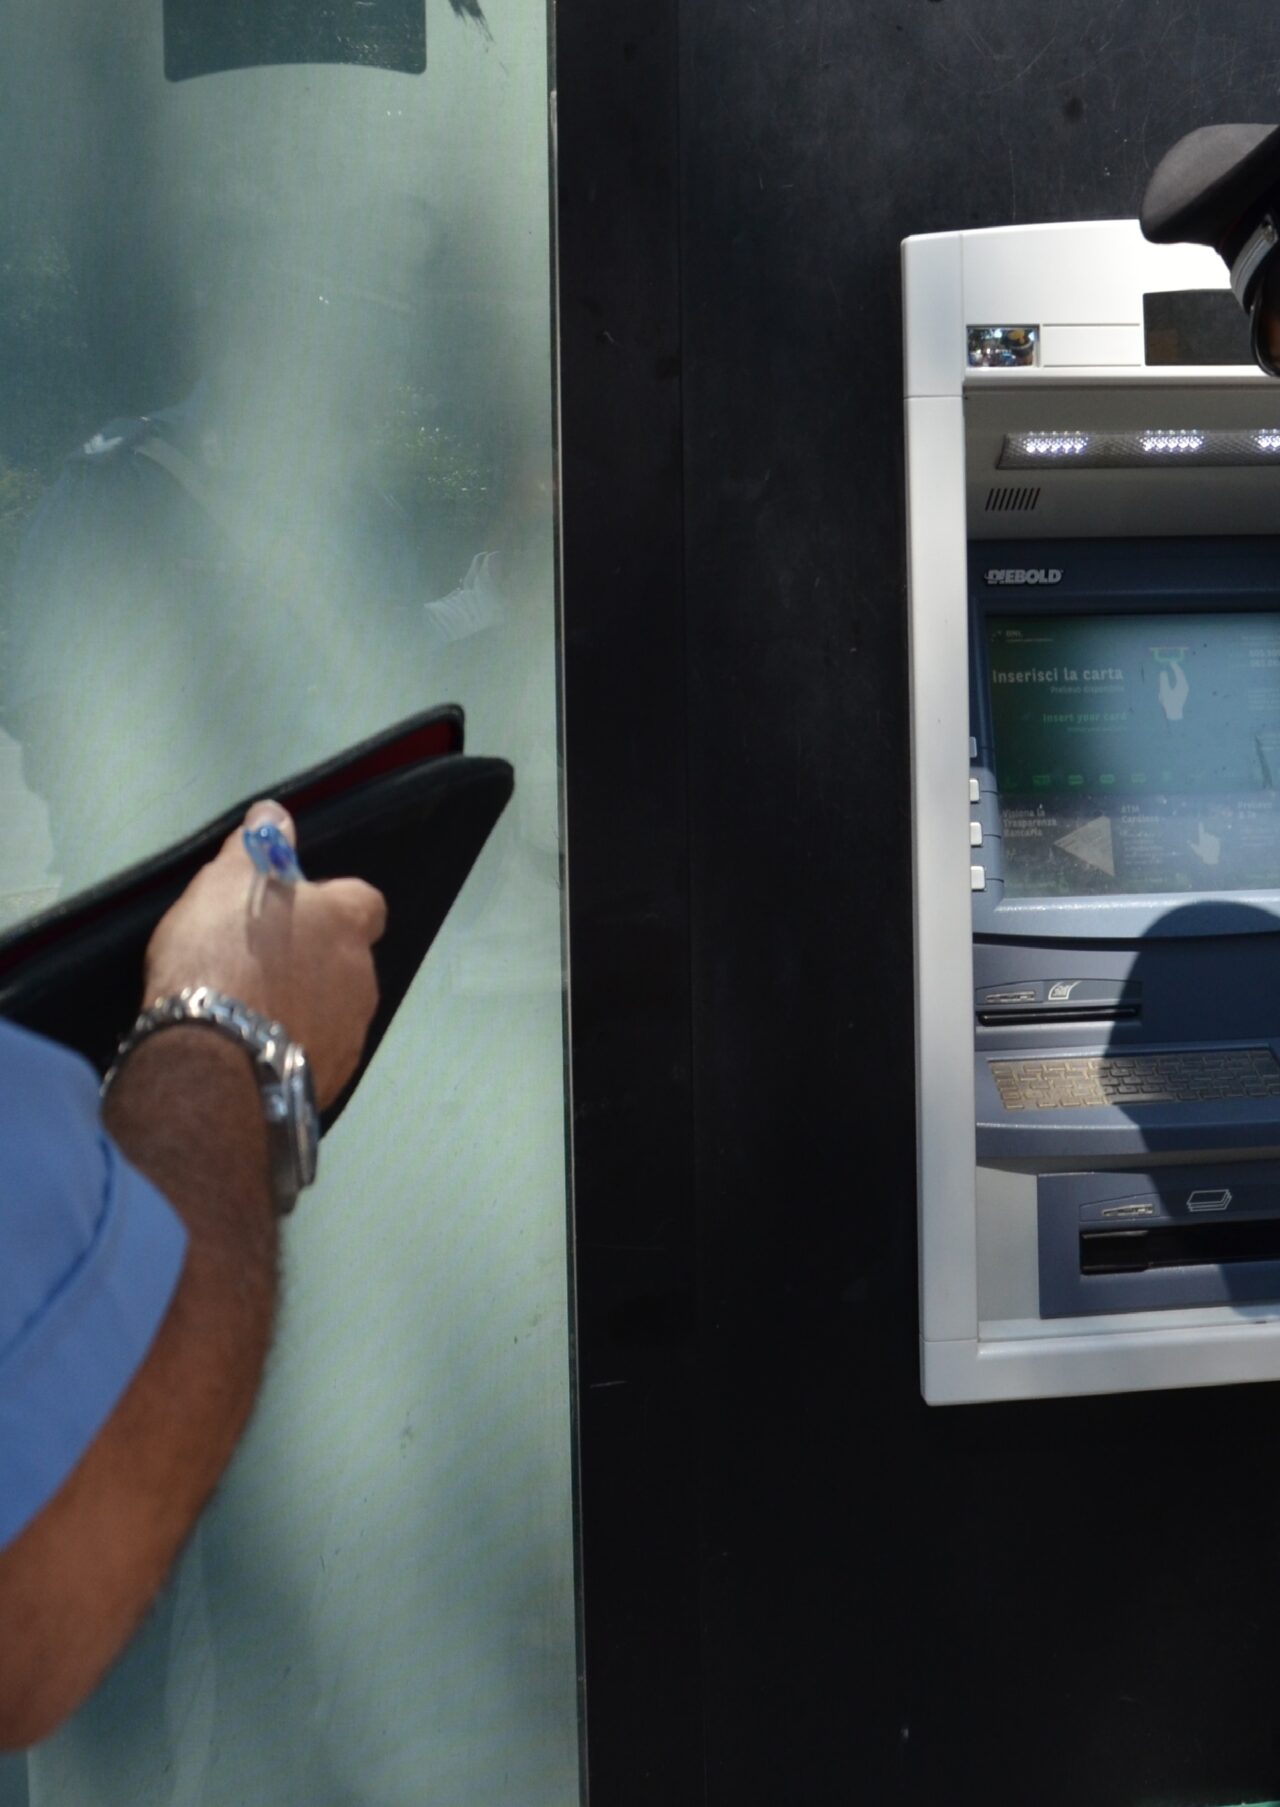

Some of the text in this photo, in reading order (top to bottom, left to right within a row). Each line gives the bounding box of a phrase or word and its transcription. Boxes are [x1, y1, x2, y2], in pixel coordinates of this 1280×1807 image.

[984, 569, 1062, 584] DIEBOLD
[992, 667, 1124, 684] Inserisci la carta
[1043, 712, 1127, 724] Insert your card
[1002, 808, 1035, 819] Visiona
[1003, 818, 1057, 828] Trasparenza
